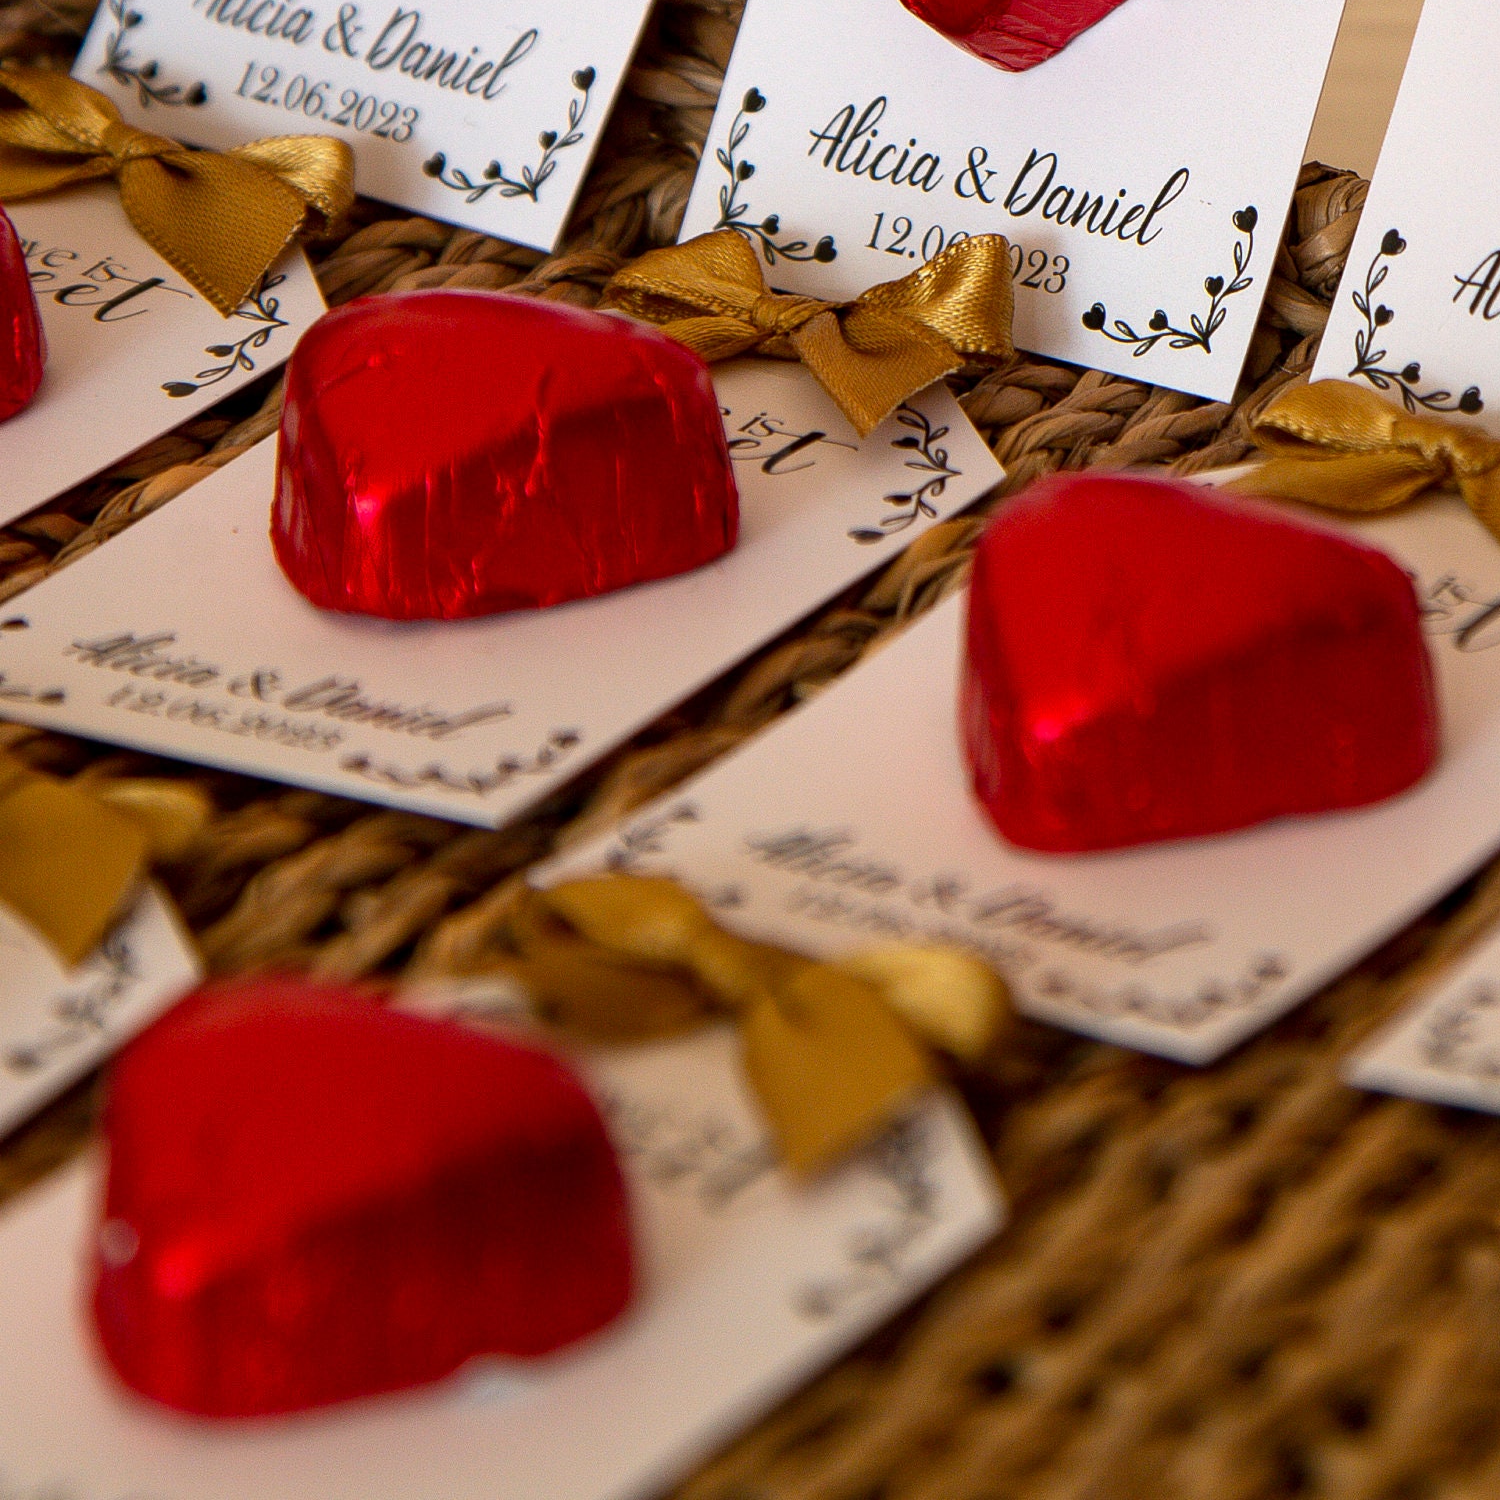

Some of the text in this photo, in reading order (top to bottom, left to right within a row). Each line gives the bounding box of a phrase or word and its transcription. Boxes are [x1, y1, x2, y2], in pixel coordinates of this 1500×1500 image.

[320, 2, 364, 58] &
[365, 5, 540, 101] Daniel
[234, 60, 420, 143] 12.06.2023
[808, 95, 1190, 246] Alicia & Daniel
[82, 257, 126, 282] is
[865, 211, 1071, 295] 12.0023
[29, 271, 193, 322] eet
